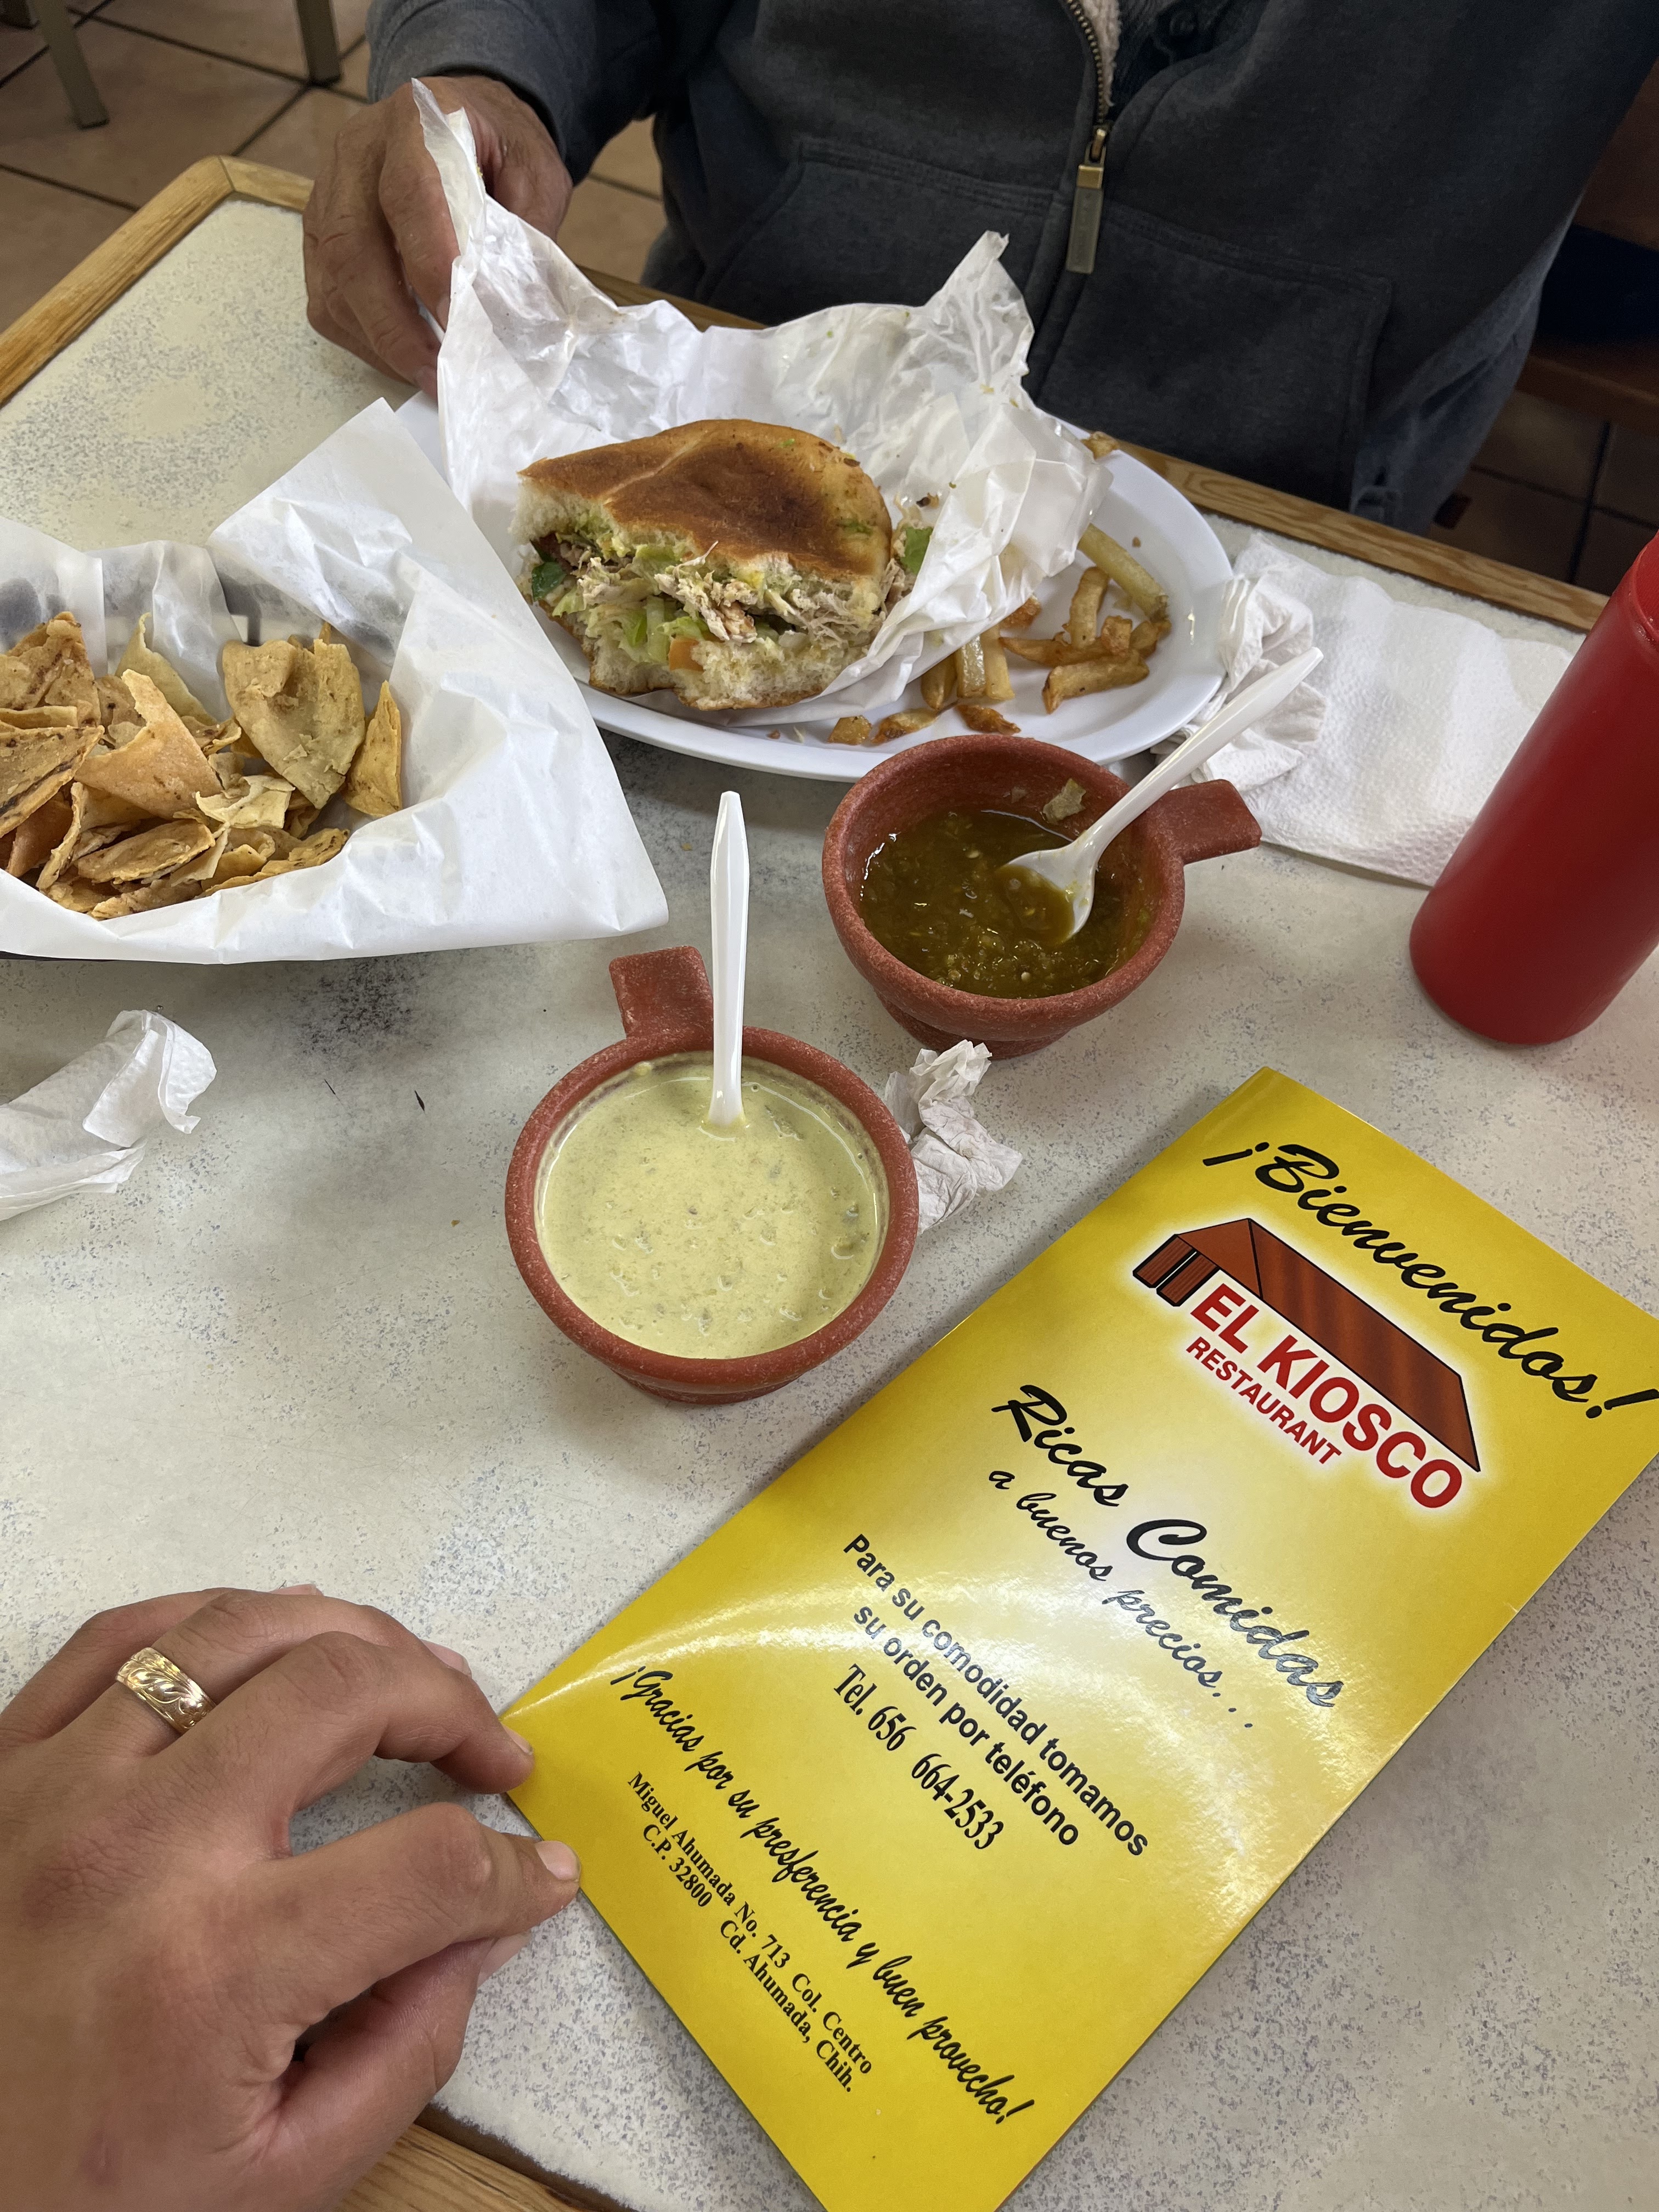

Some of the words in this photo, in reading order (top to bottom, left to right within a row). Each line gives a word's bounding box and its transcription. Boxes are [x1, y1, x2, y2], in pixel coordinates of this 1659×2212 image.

[1203, 1142, 1658, 1419] ¡Bienvenidos!
[1186, 1336, 1342, 1465] RESTAURANT
[1190, 1283, 1260, 1354] EL
[1257, 1334, 1462, 1509] KIOSCO
[989, 1470, 1014, 1489] a
[1016, 1492, 1113, 1582] buenos
[991, 1385, 1129, 1506] Ricas
[1126, 1519, 1344, 1707] Comidas
[611, 1666, 704, 1752] ¡Gracias
[833, 1663, 877, 1716] Tel.
[868, 1706, 917, 1751] 656
[911, 1753, 1005, 1849] 664-2533
[843, 1533, 895, 1592] Para
[892, 1588, 926, 1621] su
[922, 1619, 1048, 1745] comodidad
[1039, 1737, 1148, 1855] tomamos
[854, 1606, 886, 1640] su
[883, 1638, 948, 1706] orden
[939, 1702, 990, 1747] por
[985, 1742, 1079, 1846] teléfono
[685, 1751, 734, 1790] por
[728, 1790, 760, 1818] su
[627, 1772, 678, 1832] Miguel
[671, 1826, 736, 1906] Ahumada
[734, 1901, 760, 1938] No.
[761, 1934, 791, 1968] 713
[792, 1973, 823, 2013] Col.
[822, 2011, 872, 2074] Centro
[740, 1817, 862, 1942] presferencia
[642, 1824, 670, 1860] C.P.
[669, 1859, 712, 1908] 32800
[719, 1920, 746, 1955] Cd.
[743, 1951, 812, 2044] Ahumada,
[816, 2040, 853, 2092] Chih.
[847, 1942, 880, 1969] y
[872, 1956, 926, 2017] buen
[907, 2016, 1035, 2124] provecho!
